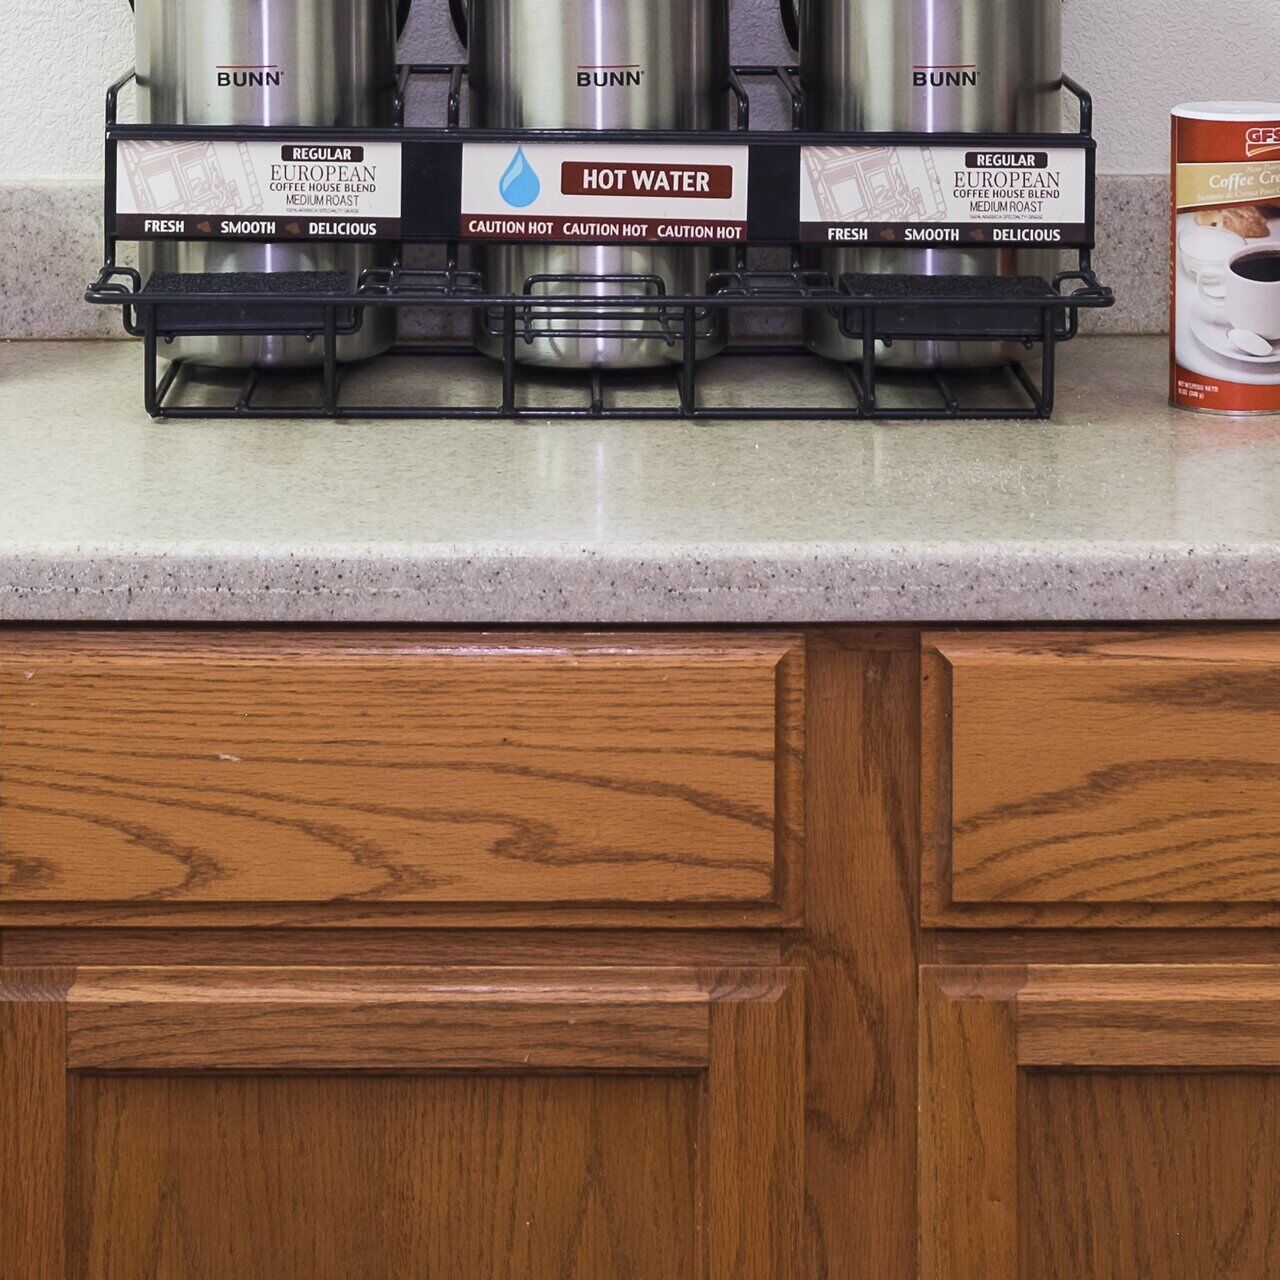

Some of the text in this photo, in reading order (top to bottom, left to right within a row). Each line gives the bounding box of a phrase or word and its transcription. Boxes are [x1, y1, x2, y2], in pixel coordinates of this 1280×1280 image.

[217, 71, 280, 87] BUNN
[577, 71, 640, 87] BUNN
[913, 71, 976, 87] BUNN
[292, 148, 352, 160] REGULAR
[976, 154, 1035, 167] REGULAR
[270, 164, 377, 182] EUROPEAN
[583, 169, 710, 192] HOT WATER
[954, 171, 1060, 188] EUROPEAN
[269, 182, 376, 193] COFFEE HOUSE BLEND
[1209, 172, 1255, 191] Coffee
[286, 194, 360, 206] MEDIUM ROAST
[953, 189, 1060, 199] COFFEE HOUSE BLEND
[970, 201, 1043, 213] MEDIUM ROAST
[144, 220, 377, 235] FRESH SMOOTH DELICIOUS
[468, 220, 742, 239] CAUTION HOT CAUTION HOT CAUTION HOT
[827, 228, 1061, 241] FRESH SMOOTH DELICIOUS
